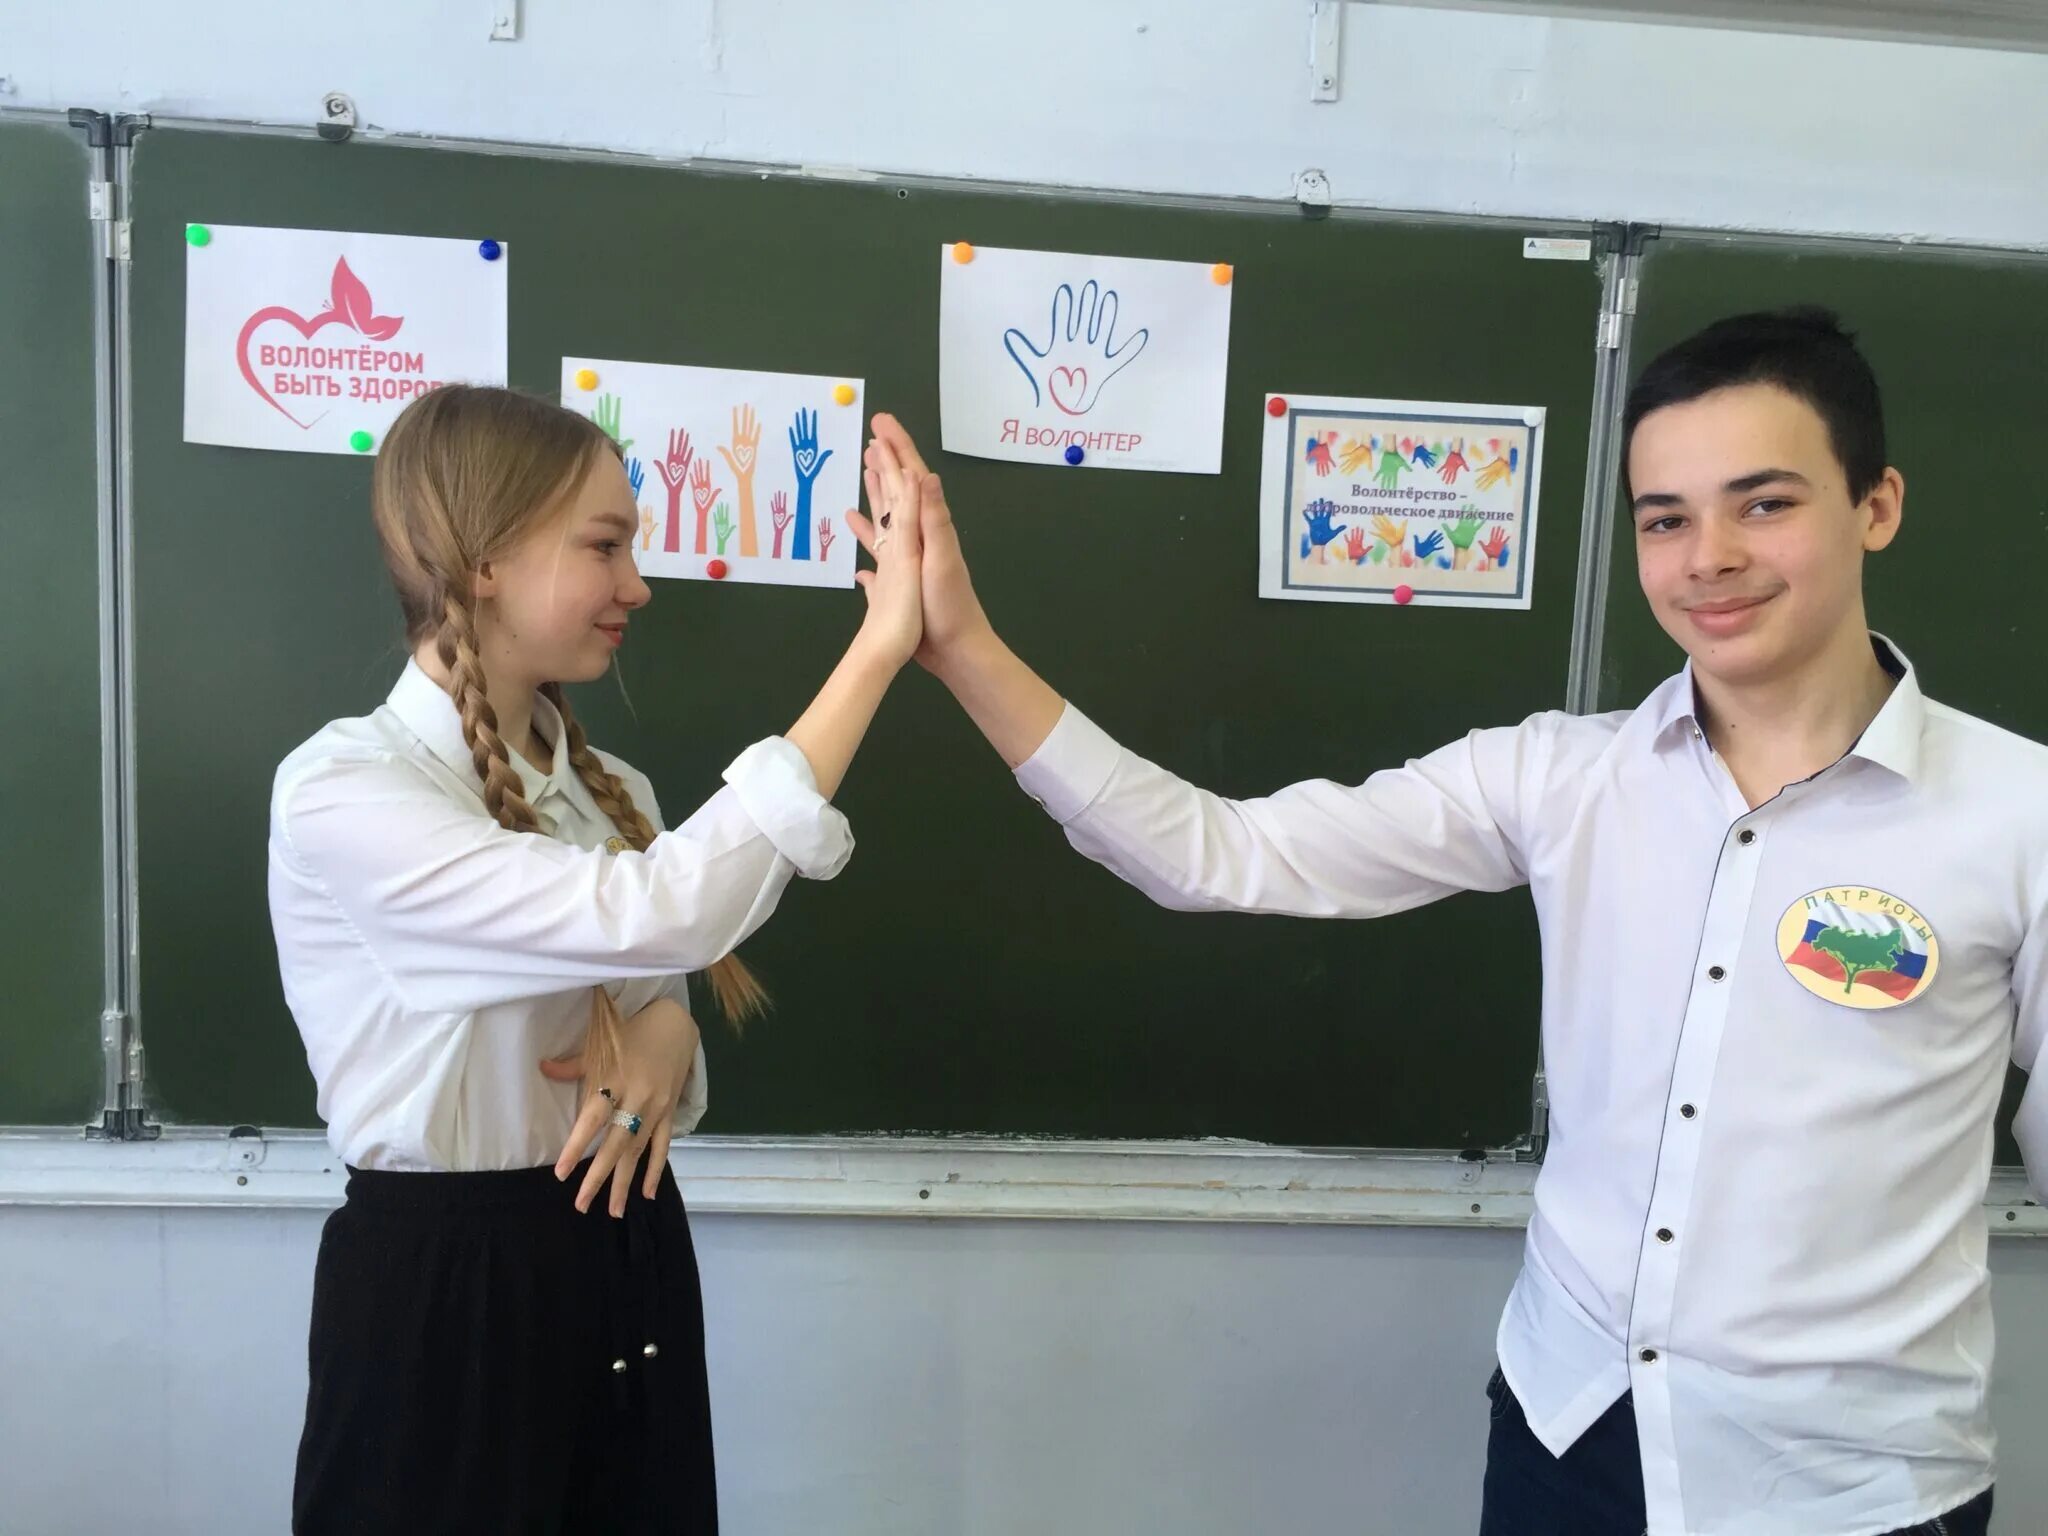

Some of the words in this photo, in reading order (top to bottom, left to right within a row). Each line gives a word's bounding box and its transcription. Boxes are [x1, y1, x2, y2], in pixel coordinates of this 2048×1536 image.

[260, 345, 424, 374] ВОЛОНТЁРОМ
[274, 373, 341, 397] БЫТЬ
[1000, 419, 1019, 444] Я
[1025, 427, 1142, 452] ВОЛОНТЕР
[1351, 484, 1457, 503] Волонтёрство
[1438, 509, 1514, 522] движение
[1804, 890, 1933, 941] ПАТРИОТЫ
